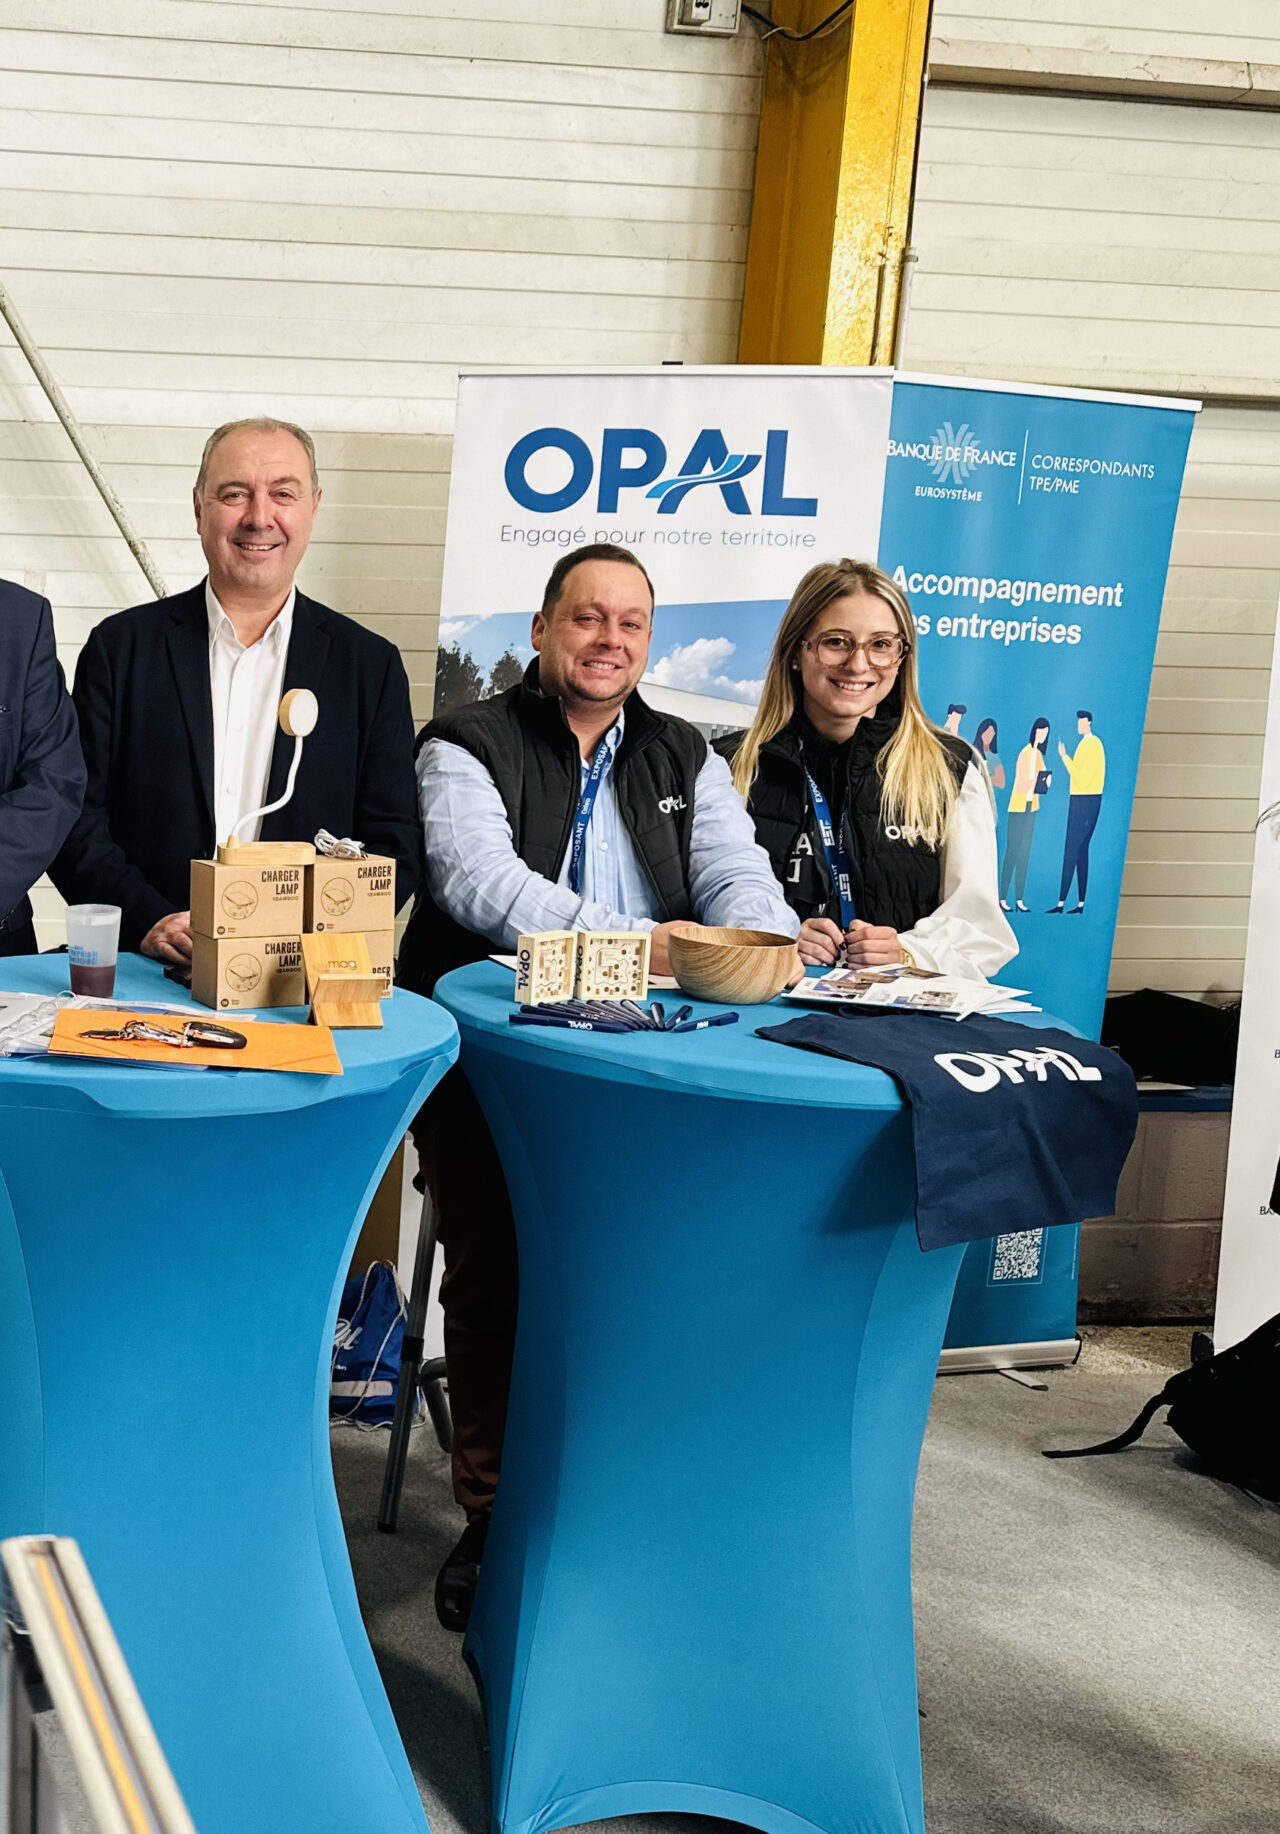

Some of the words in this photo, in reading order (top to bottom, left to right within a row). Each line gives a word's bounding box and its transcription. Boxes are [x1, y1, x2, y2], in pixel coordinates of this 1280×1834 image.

[887, 440, 943, 461] BANQUE
[945, 447, 961, 462] DE
[963, 446, 1017, 467] FRANCE
[504, 427, 819, 517] OPAL
[1031, 454, 1155, 478] CORRESPONDANTS
[1029, 476, 1080, 494] TPE/PME
[500, 524, 586, 547] Engagé
[594, 529, 646, 546] pour
[653, 529, 713, 546] notre
[721, 528, 817, 549] territoire
[891, 565, 1124, 608] Accompagnement
[936, 613, 1082, 647] entreprises
[262, 870, 300, 883] CHARGER
[358, 866, 392, 879] CHARGER
[275, 884, 299, 895] LAMP
[370, 879, 392, 891] LAMP
[265, 942, 301, 955] CHARGER
[279, 955, 301, 967] LAMP
[517, 949, 531, 990] OPAL
[933, 1046, 1103, 1093] OPAL
